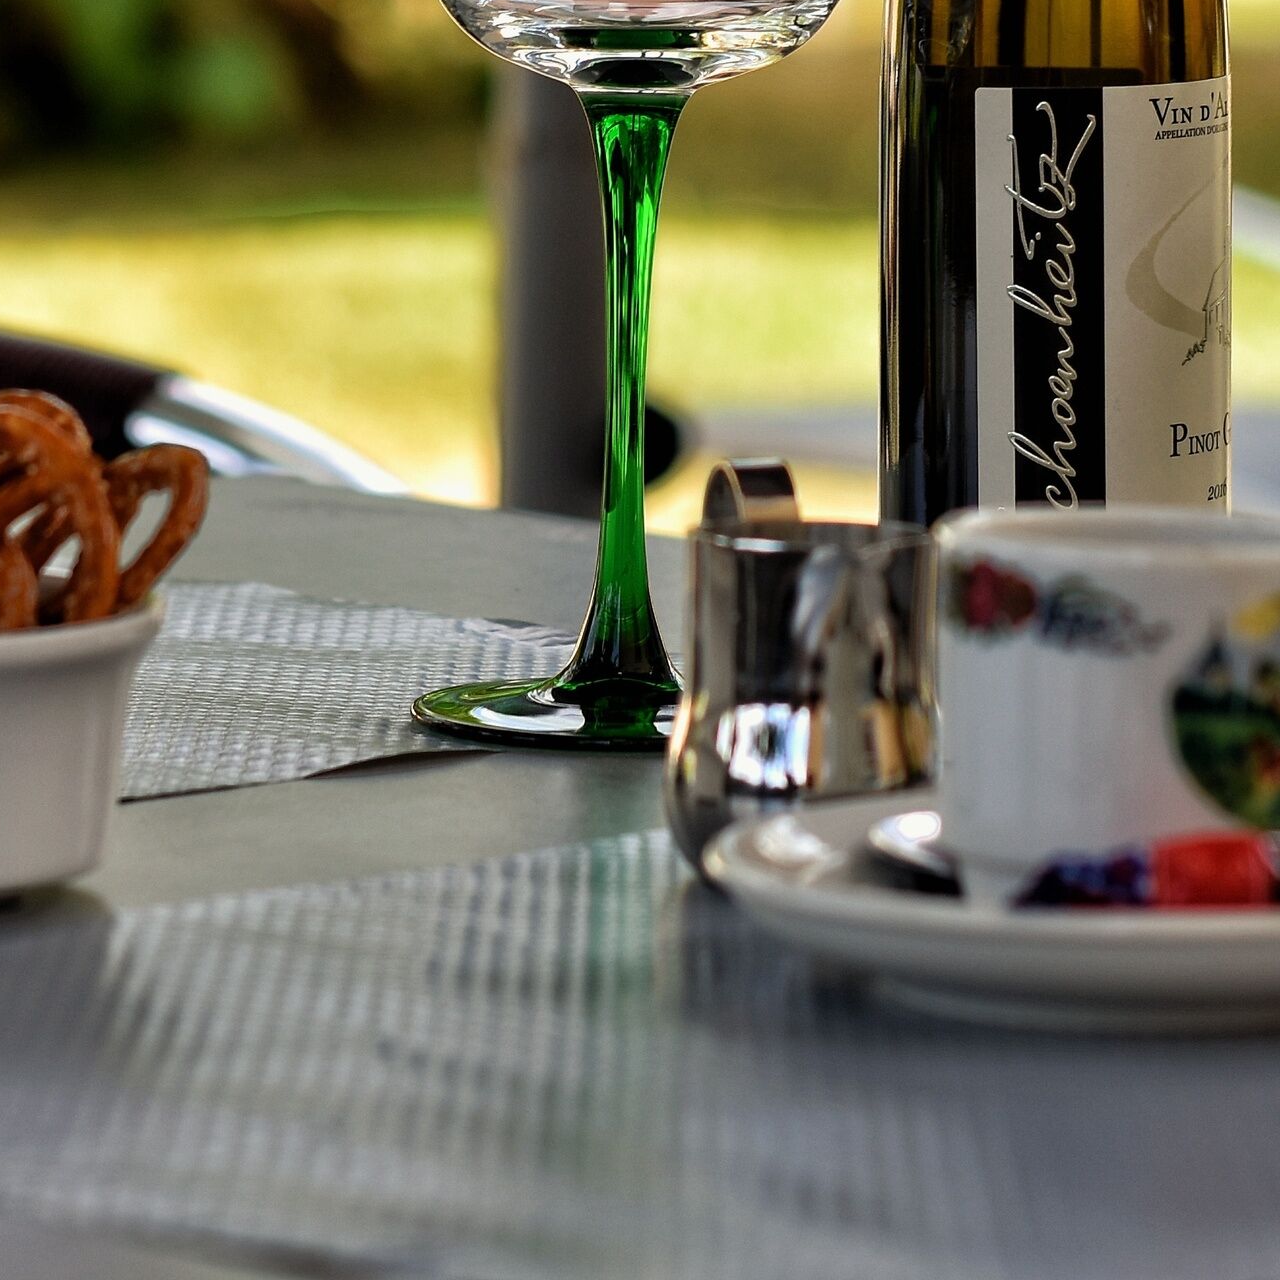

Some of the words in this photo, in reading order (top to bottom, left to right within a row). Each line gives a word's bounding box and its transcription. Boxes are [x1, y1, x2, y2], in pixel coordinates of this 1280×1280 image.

[1155, 127, 1206, 140] APPELLATION
[1005, 101, 1097, 512] choenheitz
[1169, 423, 1221, 458] PINOT
